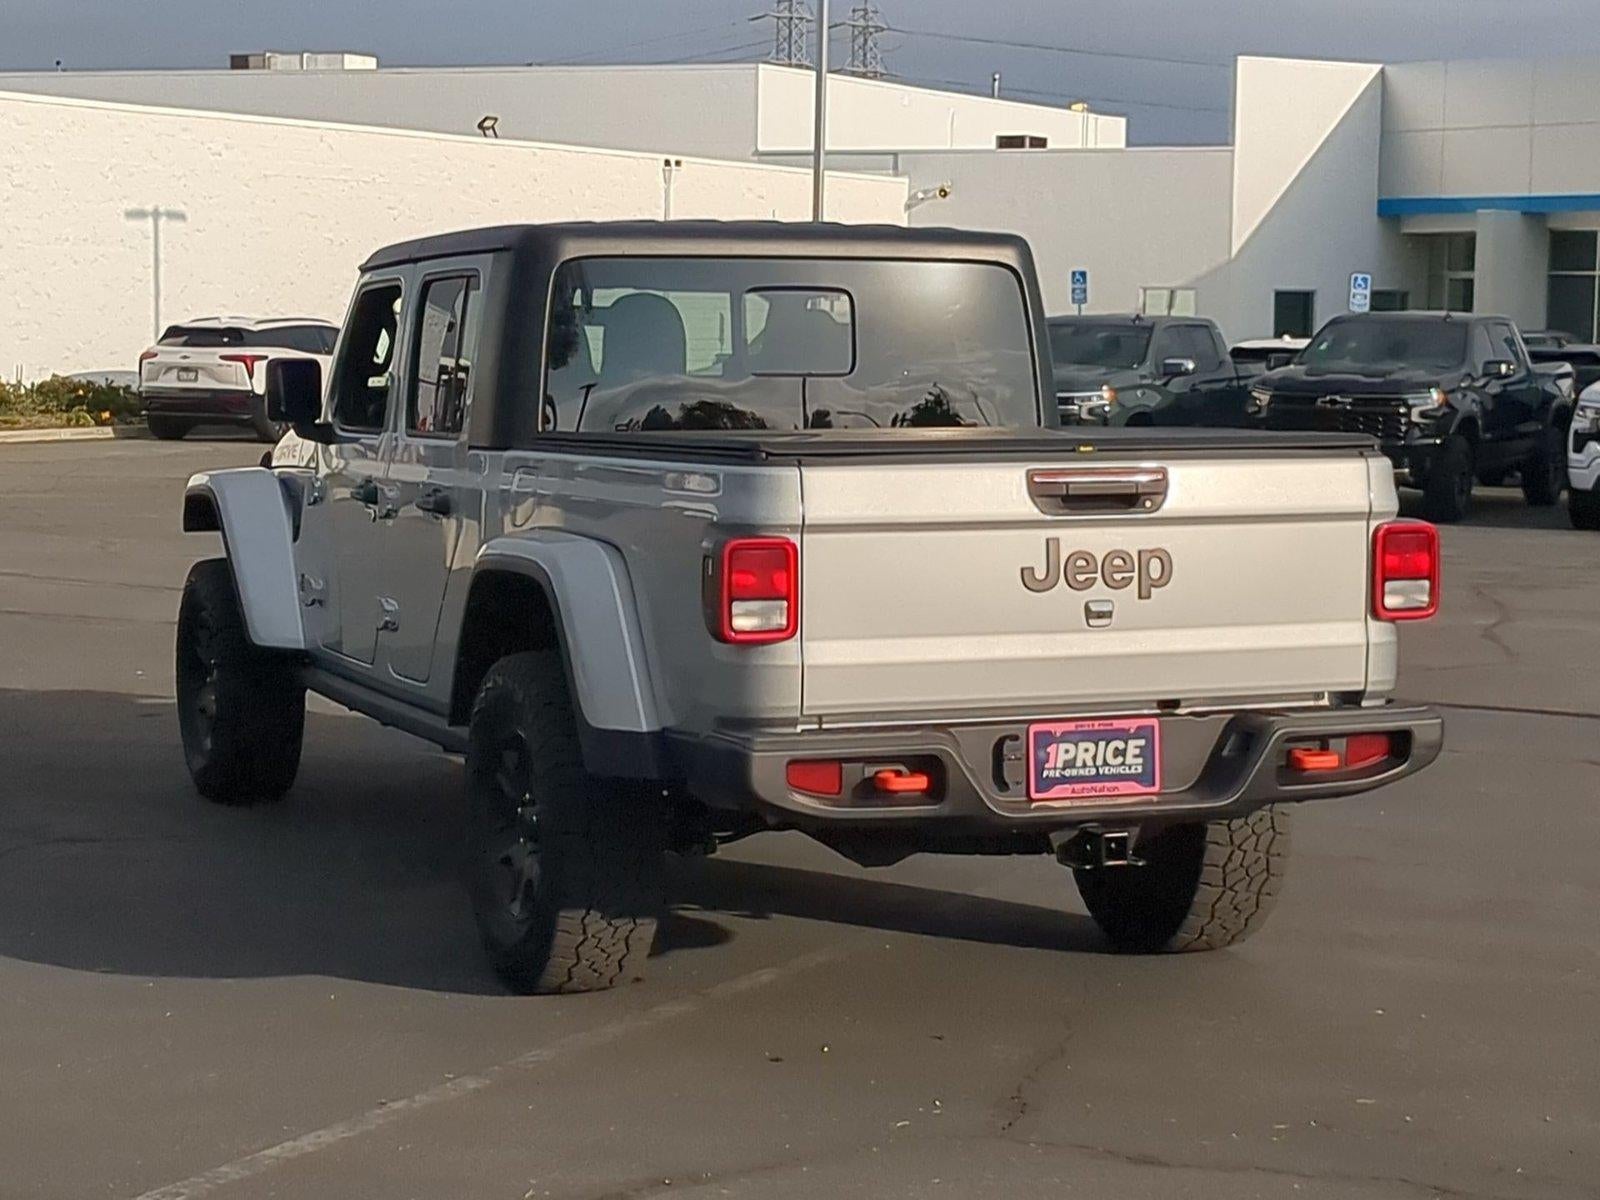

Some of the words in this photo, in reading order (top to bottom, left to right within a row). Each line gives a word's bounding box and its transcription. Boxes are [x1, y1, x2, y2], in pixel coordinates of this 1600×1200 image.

[1020, 537, 1173, 600] Jeep
[1042, 766, 1097, 779] PRE-OWNED
[1098, 765, 1144, 776] VEHICLES
[1070, 785, 1120, 796] AutoNation
